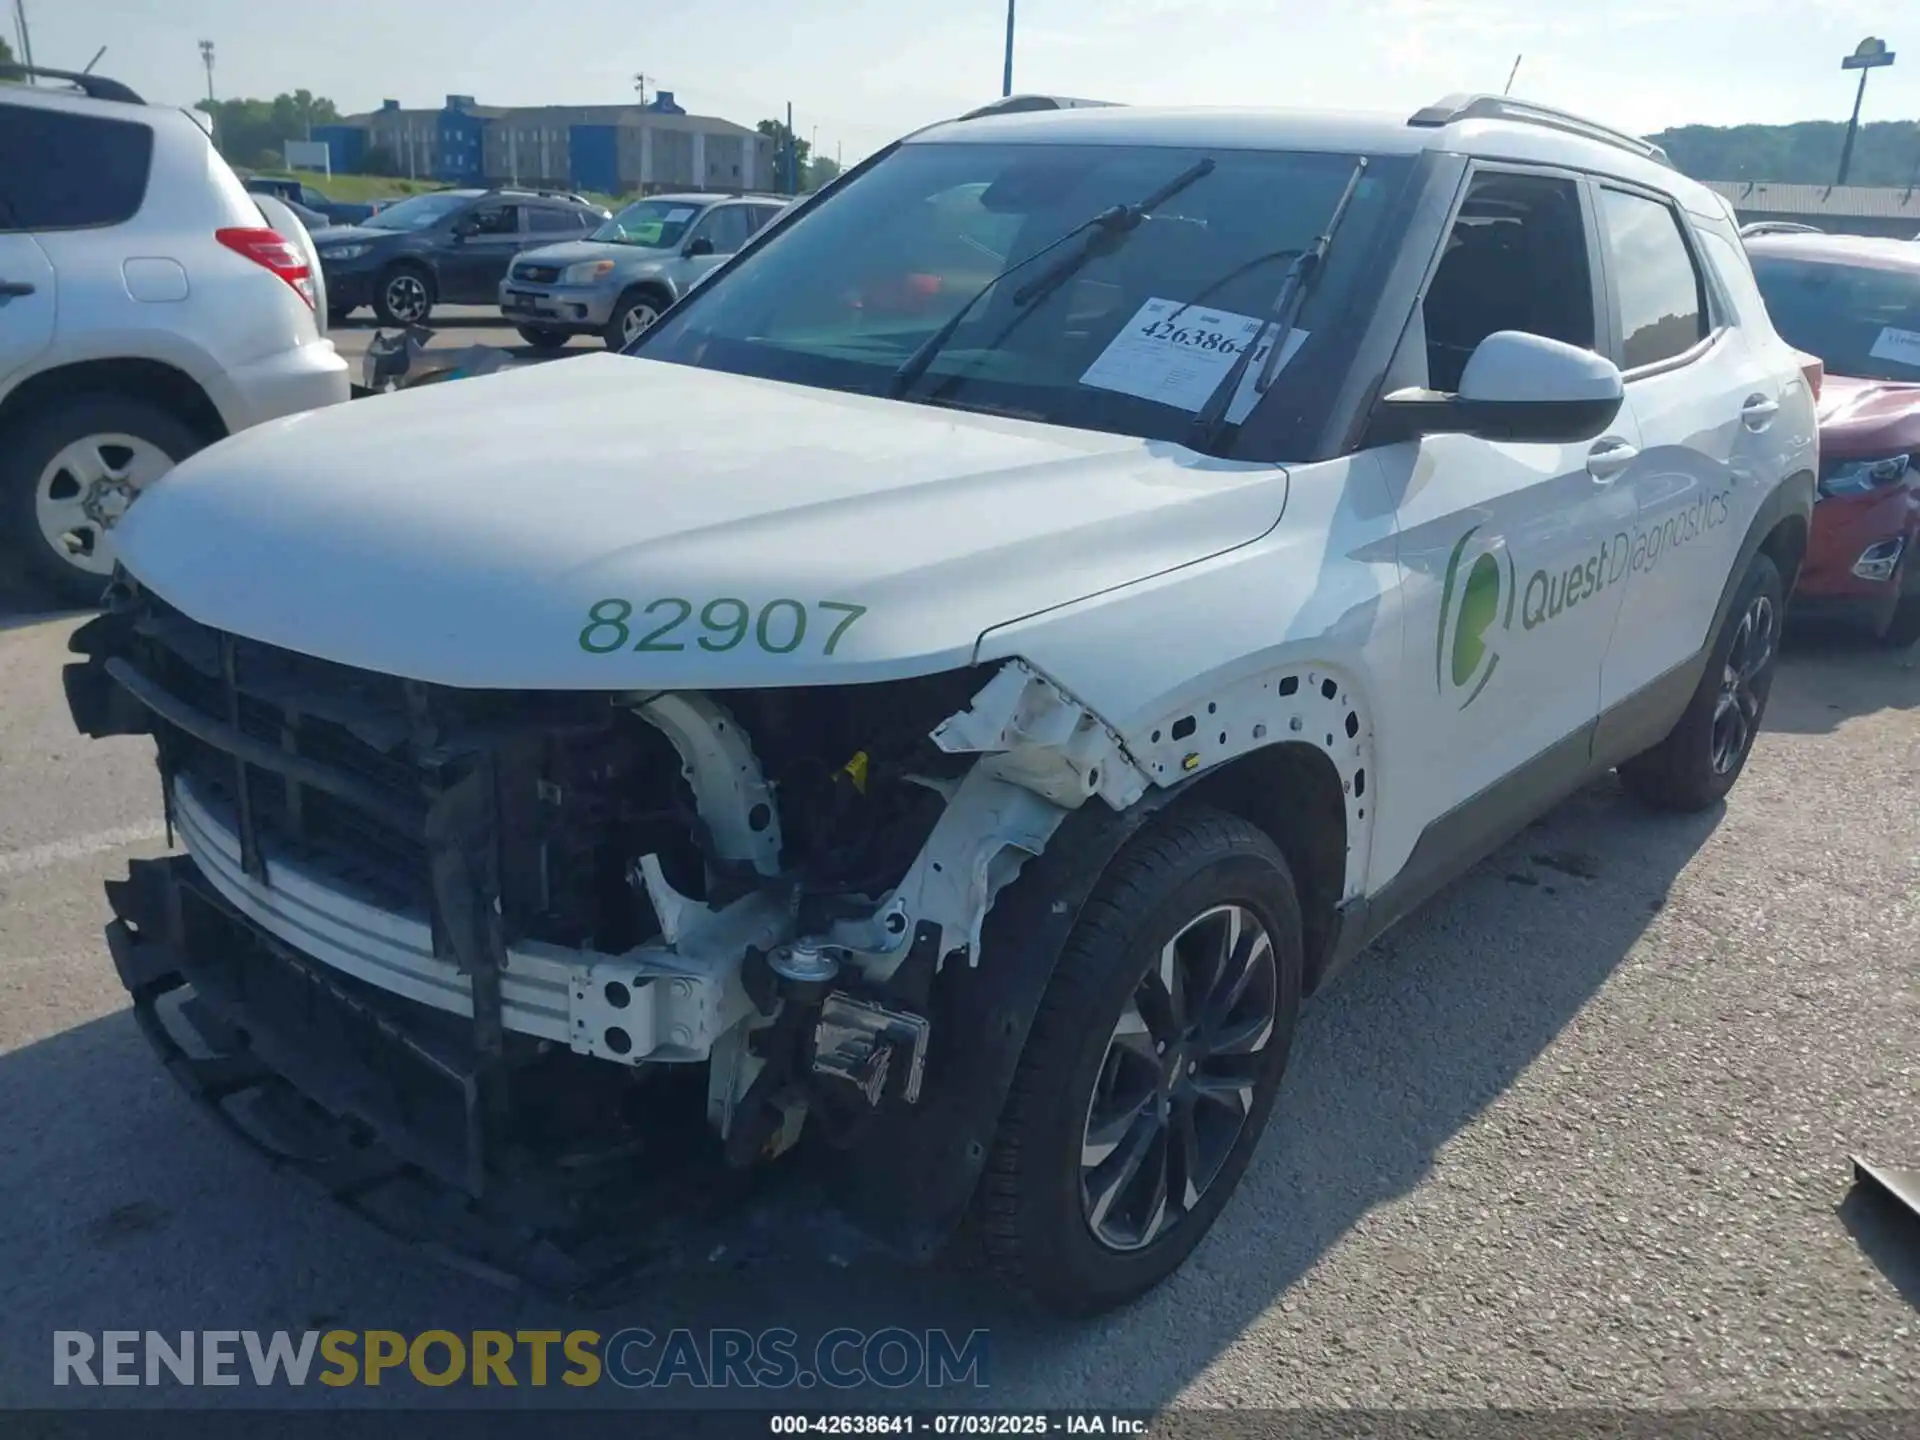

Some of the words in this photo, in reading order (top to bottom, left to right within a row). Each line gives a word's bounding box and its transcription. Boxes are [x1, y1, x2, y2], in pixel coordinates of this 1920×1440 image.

[1522, 541, 1608, 630] Quest
[1608, 487, 1731, 584] Diagnostics
[578, 598, 867, 656] 82907
